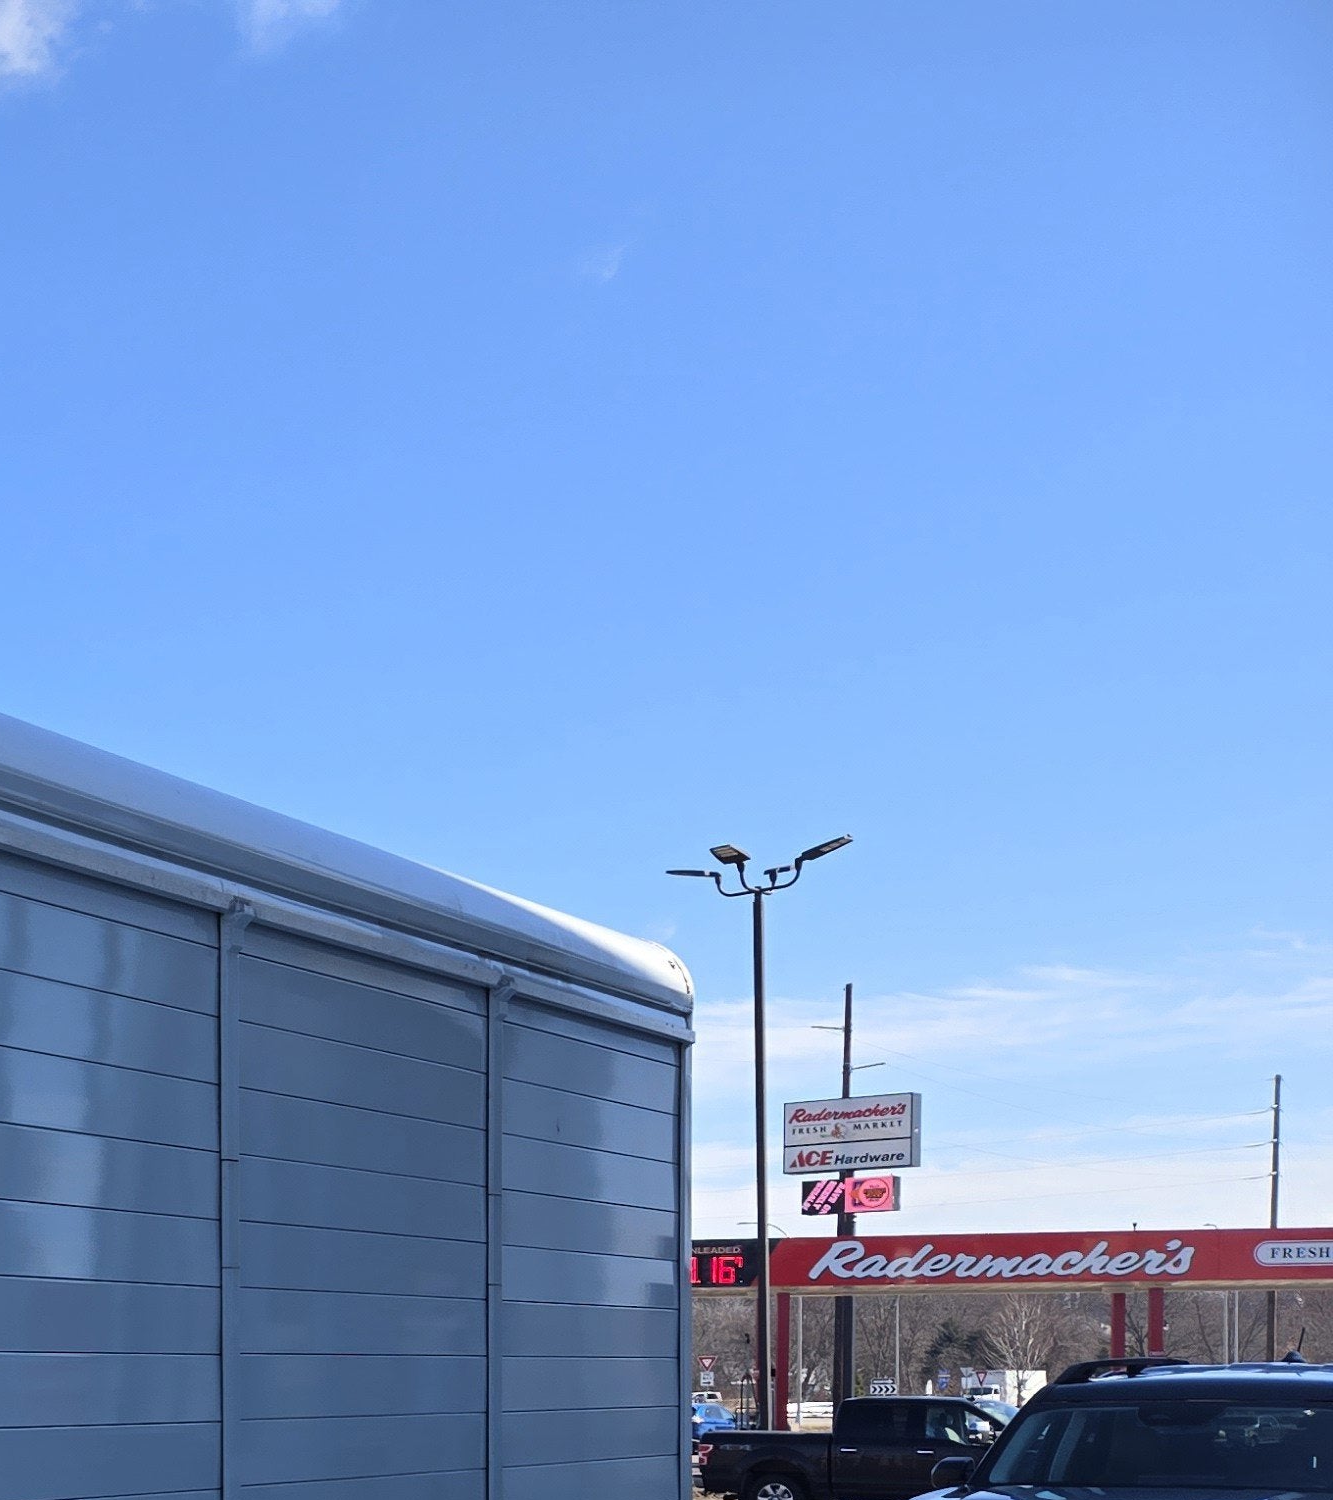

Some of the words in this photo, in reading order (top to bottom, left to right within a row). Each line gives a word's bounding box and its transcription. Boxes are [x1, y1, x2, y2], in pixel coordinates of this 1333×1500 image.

[788, 1103, 907, 1124] Radermacher's
[792, 1126, 827, 1135] FRESH
[853, 1120, 903, 1130] MARKET
[789, 1150, 834, 1168] ACE
[834, 1152, 905, 1165] Hardware
[808, 1239, 1195, 1280] Radermacher's
[1270, 1247, 1330, 1258] FRESH
